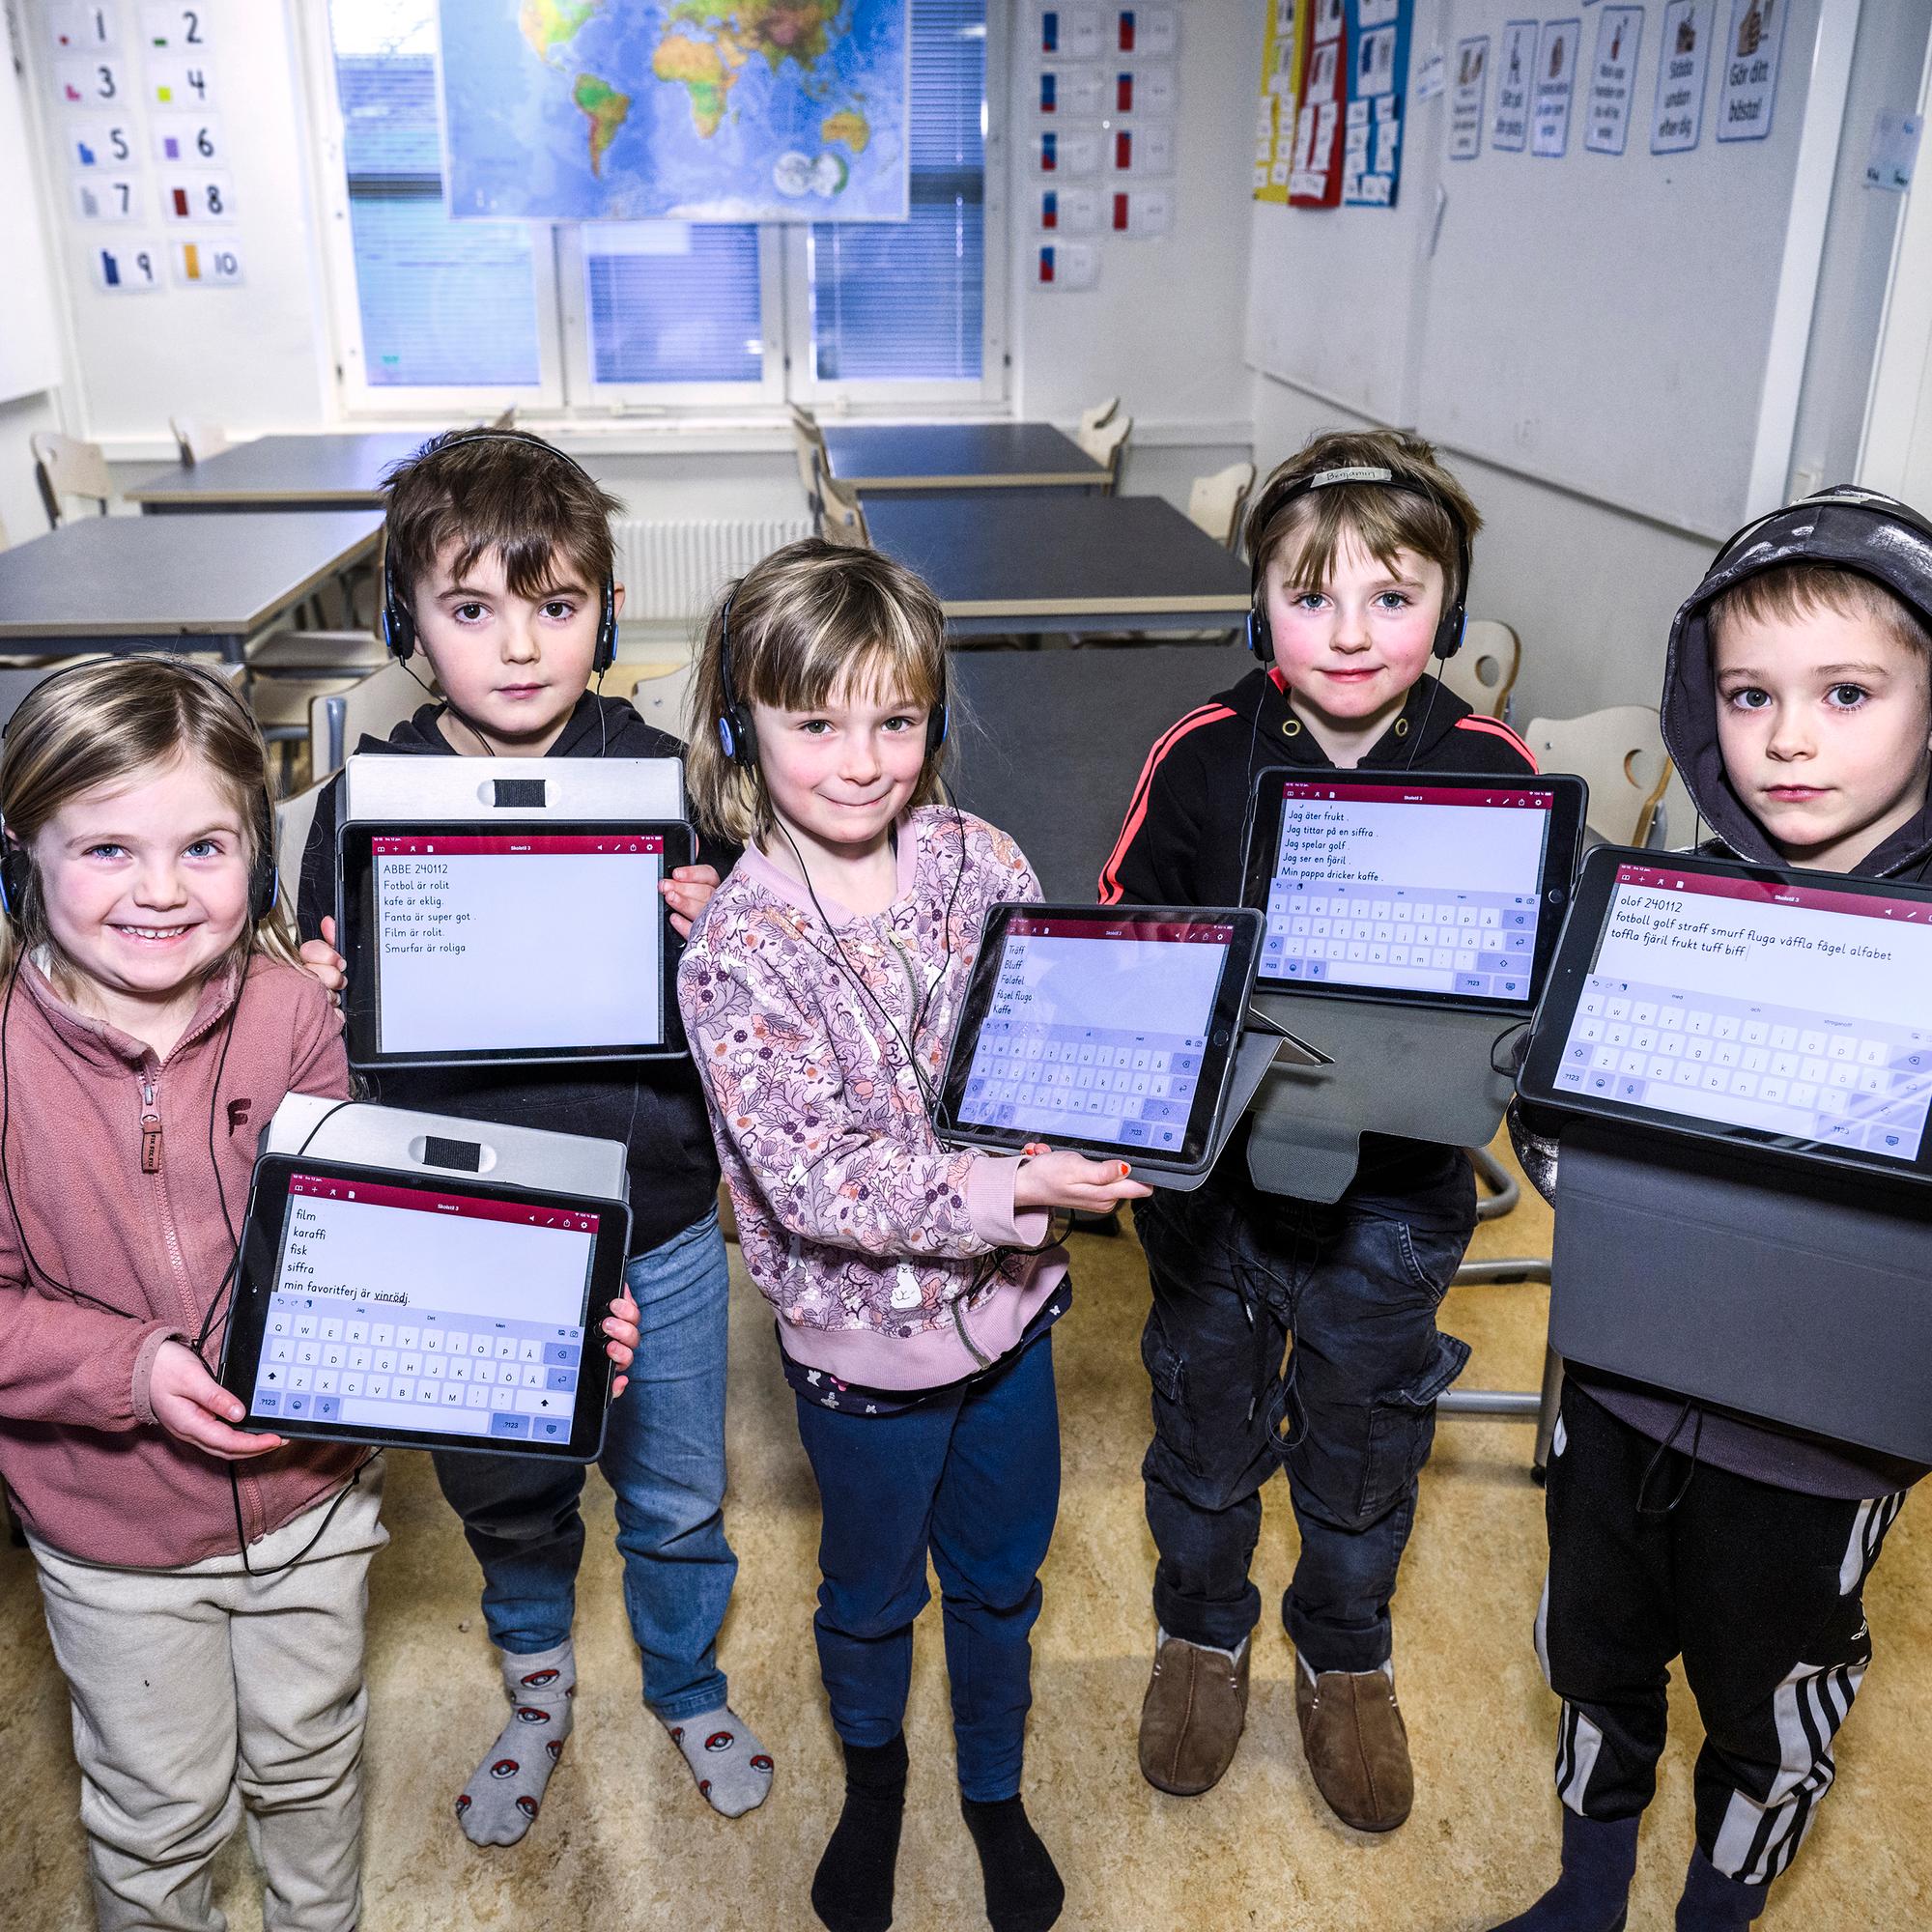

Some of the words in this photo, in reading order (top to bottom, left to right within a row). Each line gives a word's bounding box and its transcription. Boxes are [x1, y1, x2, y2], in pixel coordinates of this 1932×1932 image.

[97, 8, 106, 42] 1
[184, 12, 202, 43] 2
[1729, 63, 1749, 86] Gör
[99, 67, 116, 99] 3
[187, 70, 206, 99] 4
[110, 128, 128, 160] 5
[197, 128, 213, 157] 6
[114, 184, 129, 213] 7
[207, 185, 223, 214] 8
[137, 253, 153, 280] 9
[214, 253, 238, 275] 10
[1289, 810, 1303, 823] Jag
[1324, 811, 1344, 821] frukt
[1287, 824, 1300, 837] Jag
[1326, 827, 1336, 838] på
[1351, 827, 1373, 837] siffra
[1285, 838, 1299, 851] Jag
[1301, 839, 1326, 851] spelar
[1328, 840, 1347, 853] golf
[1283, 852, 1297, 865] Jag
[1327, 854, 1346, 867] fjäril
[384, 864, 411, 874] ABBE
[415, 864, 448, 874] 240112
[1281, 867, 1298, 876] Min
[1300, 870, 1324, 880] pappa
[1327, 869, 1354, 879] dricker
[1358, 871, 1378, 881] kaffe
[384, 880, 414, 890] Fotbol
[417, 881, 426, 890] är
[430, 880, 449, 890] rolit
[384, 895, 404, 906] kafe
[407, 897, 415, 906] är
[419, 895, 443, 909] eklig.
[1621, 895, 1643, 906] olof
[1644, 897, 1683, 913] 240112
[384, 912, 412, 922] Fanta
[414, 913, 424, 922] är
[428, 914, 452, 923] super
[456, 913, 470, 924] got
[384, 927, 407, 937] Film
[410, 928, 419, 937] är
[1616, 911, 1650, 925] fotboll
[1653, 918, 1677, 930] golf
[1678, 923, 1710, 933] straff
[1711, 925, 1746, 940] smurf
[1747, 929, 1776, 947] fluga
[1780, 936, 1812, 949] våffla
[1817, 940, 1846, 956] fågel
[1850, 946, 1891, 960] alfabet
[385, 943, 423, 953] Smurfar
[427, 944, 436, 952] är
[440, 943, 466, 955] roliga
[1611, 928, 1639, 941] toffla
[1643, 931, 1668, 946] fjäril
[1672, 936, 1697, 950] frukt
[1701, 942, 1723, 952] tuff
[1725, 944, 1746, 956] biff
[1004, 959, 1023, 970] Bluff
[1001, 974, 1024, 985] Falafel
[1014, 990, 1032, 1004] fluga
[993, 1005, 1011, 1014] Kaffe
[297, 1208, 316, 1221] film
[294, 1226, 326, 1239] karaffi
[291, 1243, 307, 1255] fisk
[287, 1262, 314, 1274] siffra
[284, 1281, 303, 1291] min
[307, 1281, 357, 1301] favoritferj
[360, 1289, 371, 1298] är
[374, 1291, 410, 1307] vinrödj.
[526, 1350, 532, 1358] Å
[530, 1376, 536, 1384] Ä
